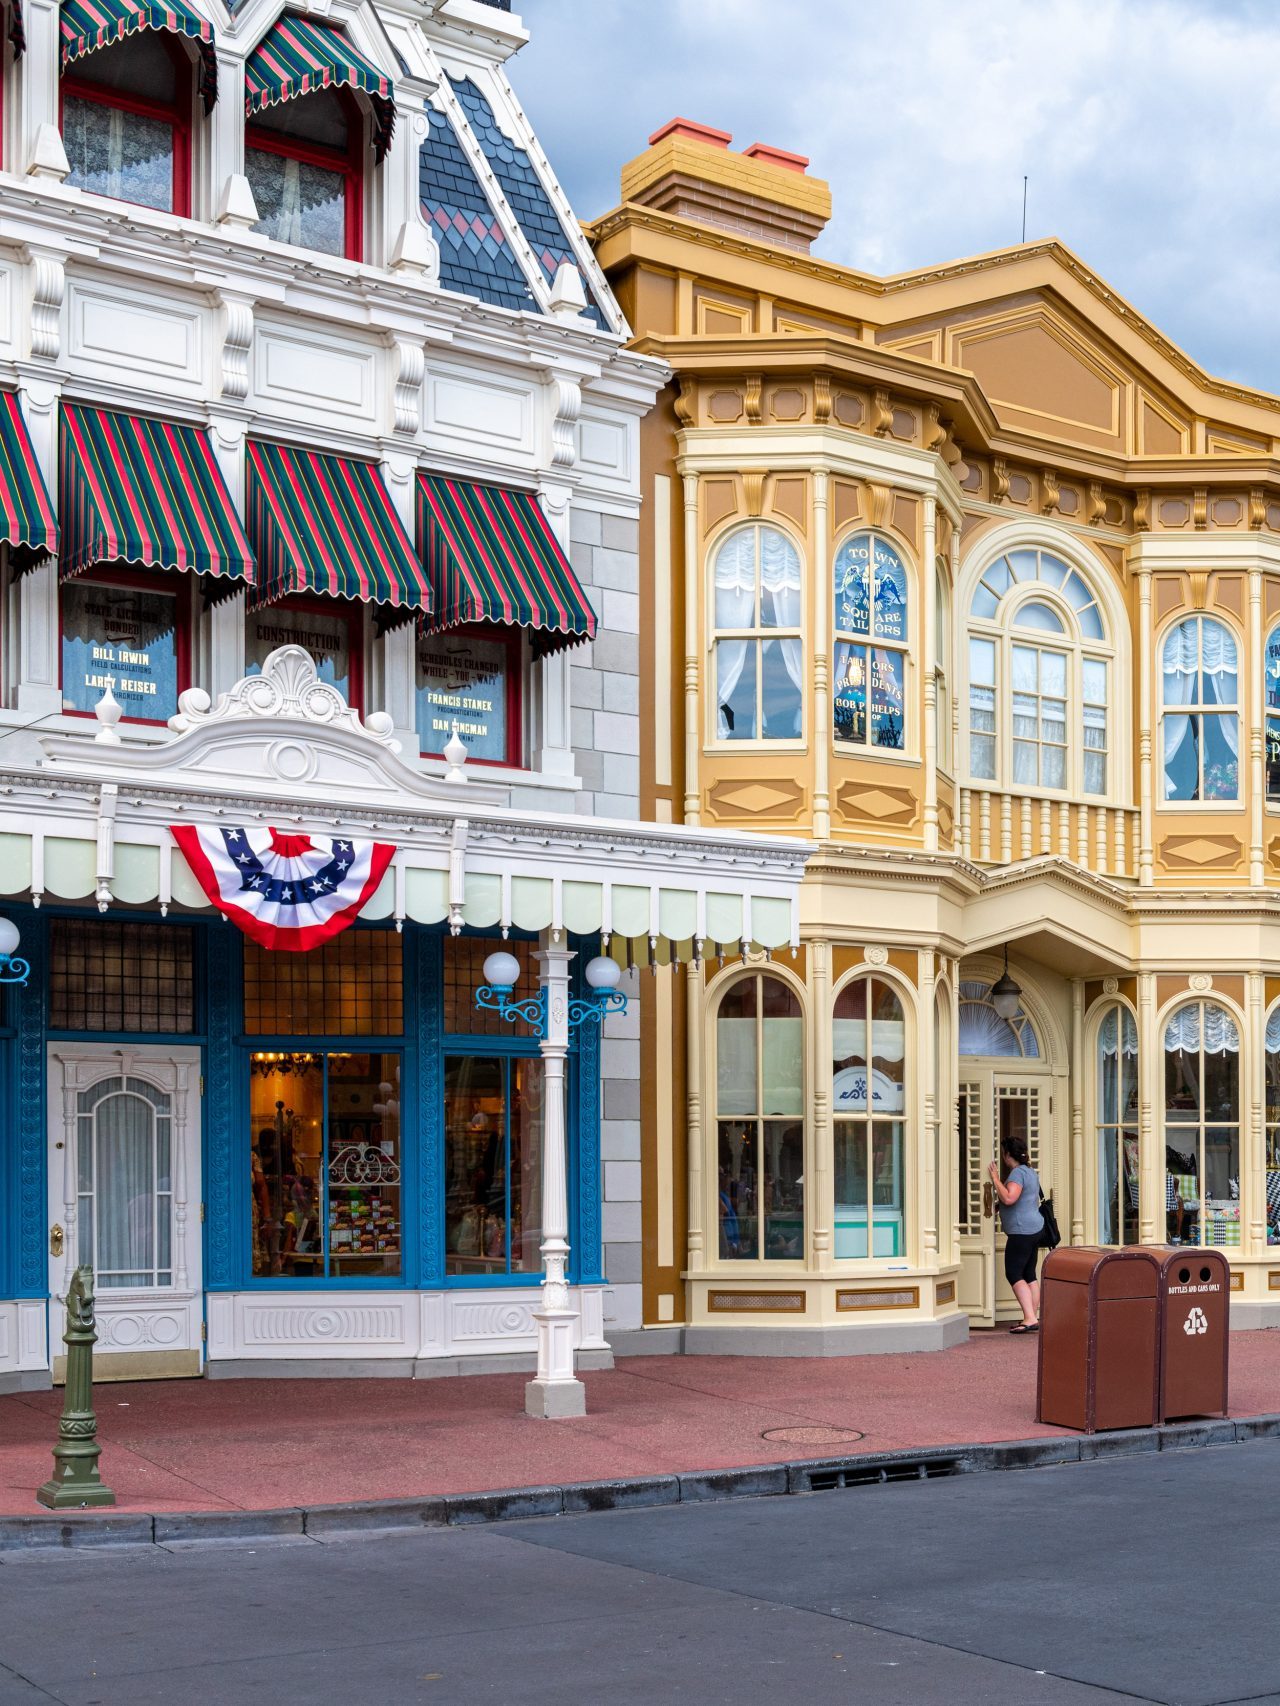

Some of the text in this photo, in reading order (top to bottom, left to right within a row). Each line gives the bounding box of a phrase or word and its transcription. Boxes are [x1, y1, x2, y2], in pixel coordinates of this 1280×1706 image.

[848, 548, 898, 568] TOWN
[85, 602, 112, 617] STATE
[842, 602, 901, 623] SQUARE
[104, 619, 139, 635] BONDED
[840, 616, 901, 636] TAILORS
[256, 625, 340, 651] CONSTRUCTION
[92, 647, 149, 666] BILL IRWIN
[420, 652, 499, 674] SCHEDULES CHANGED
[840, 655, 895, 673] TALORS
[91, 660, 152, 674] FIELD CALCULATIONS
[121, 679, 157, 694] REISER
[427, 693, 492, 712] FRANCIS STANEK
[836, 697, 900, 717] BOB PHELPS
[432, 718, 449, 731] DAN
[1168, 1283, 1220, 1294] BOTTLES AND CANS ONLY
